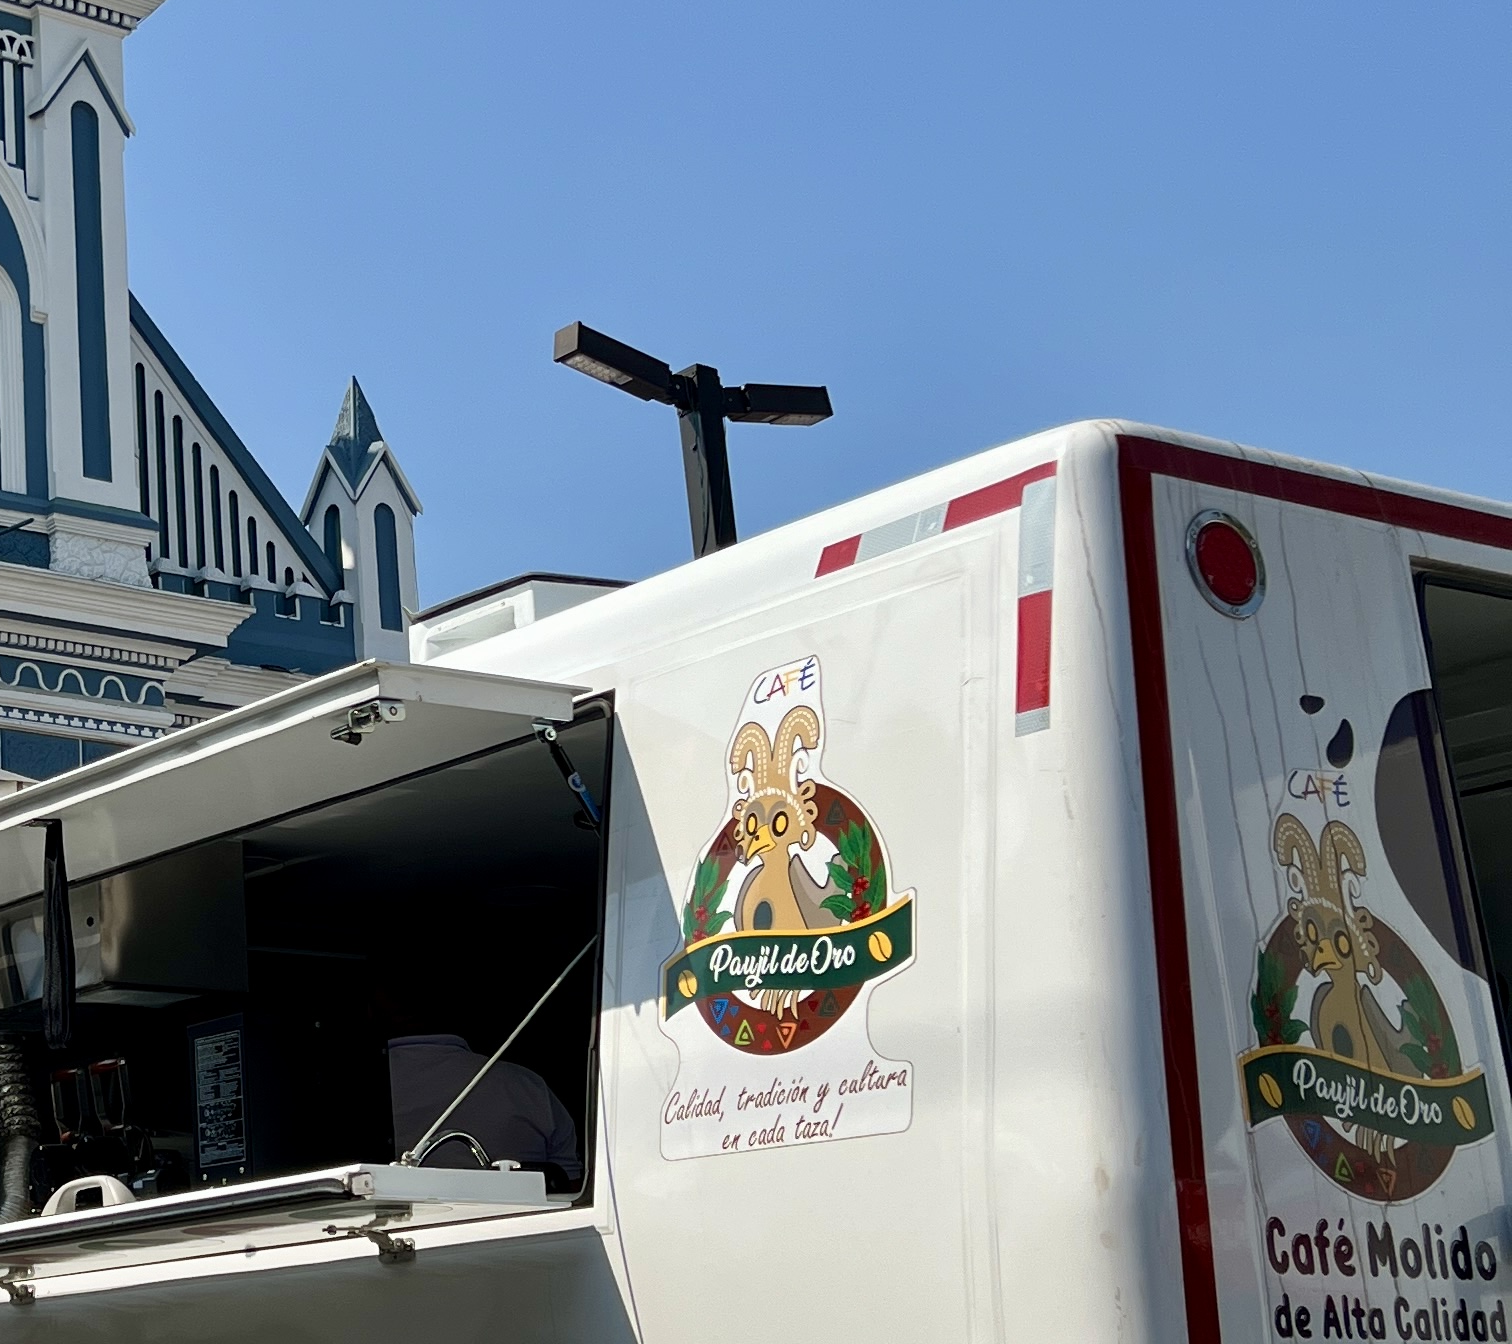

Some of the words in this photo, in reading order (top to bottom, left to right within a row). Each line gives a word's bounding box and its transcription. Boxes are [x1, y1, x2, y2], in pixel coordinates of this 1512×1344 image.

[752, 658, 817, 705] CAFÉ
[1288, 770, 1351, 807] CAFÉ
[709, 944, 780, 988] Paujil
[780, 943, 809, 974] de
[810, 936, 856, 974] Oro
[664, 1085, 727, 1125] Calidad,
[737, 1076, 810, 1112] tradición
[813, 1082, 830, 1113] y
[1292, 1058, 1368, 1118] Paujil
[1370, 1083, 1399, 1119] de
[1400, 1084, 1443, 1125] Oro
[721, 1133, 741, 1150] en
[748, 1113, 785, 1146] cada
[794, 1102, 844, 1139] taza!
[1266, 1216, 1357, 1278] Café
[1366, 1220, 1497, 1282] Molido
[1275, 1293, 1313, 1340] de
[1323, 1294, 1387, 1341] Alta
[1394, 1296, 1508, 1343] Calidad
